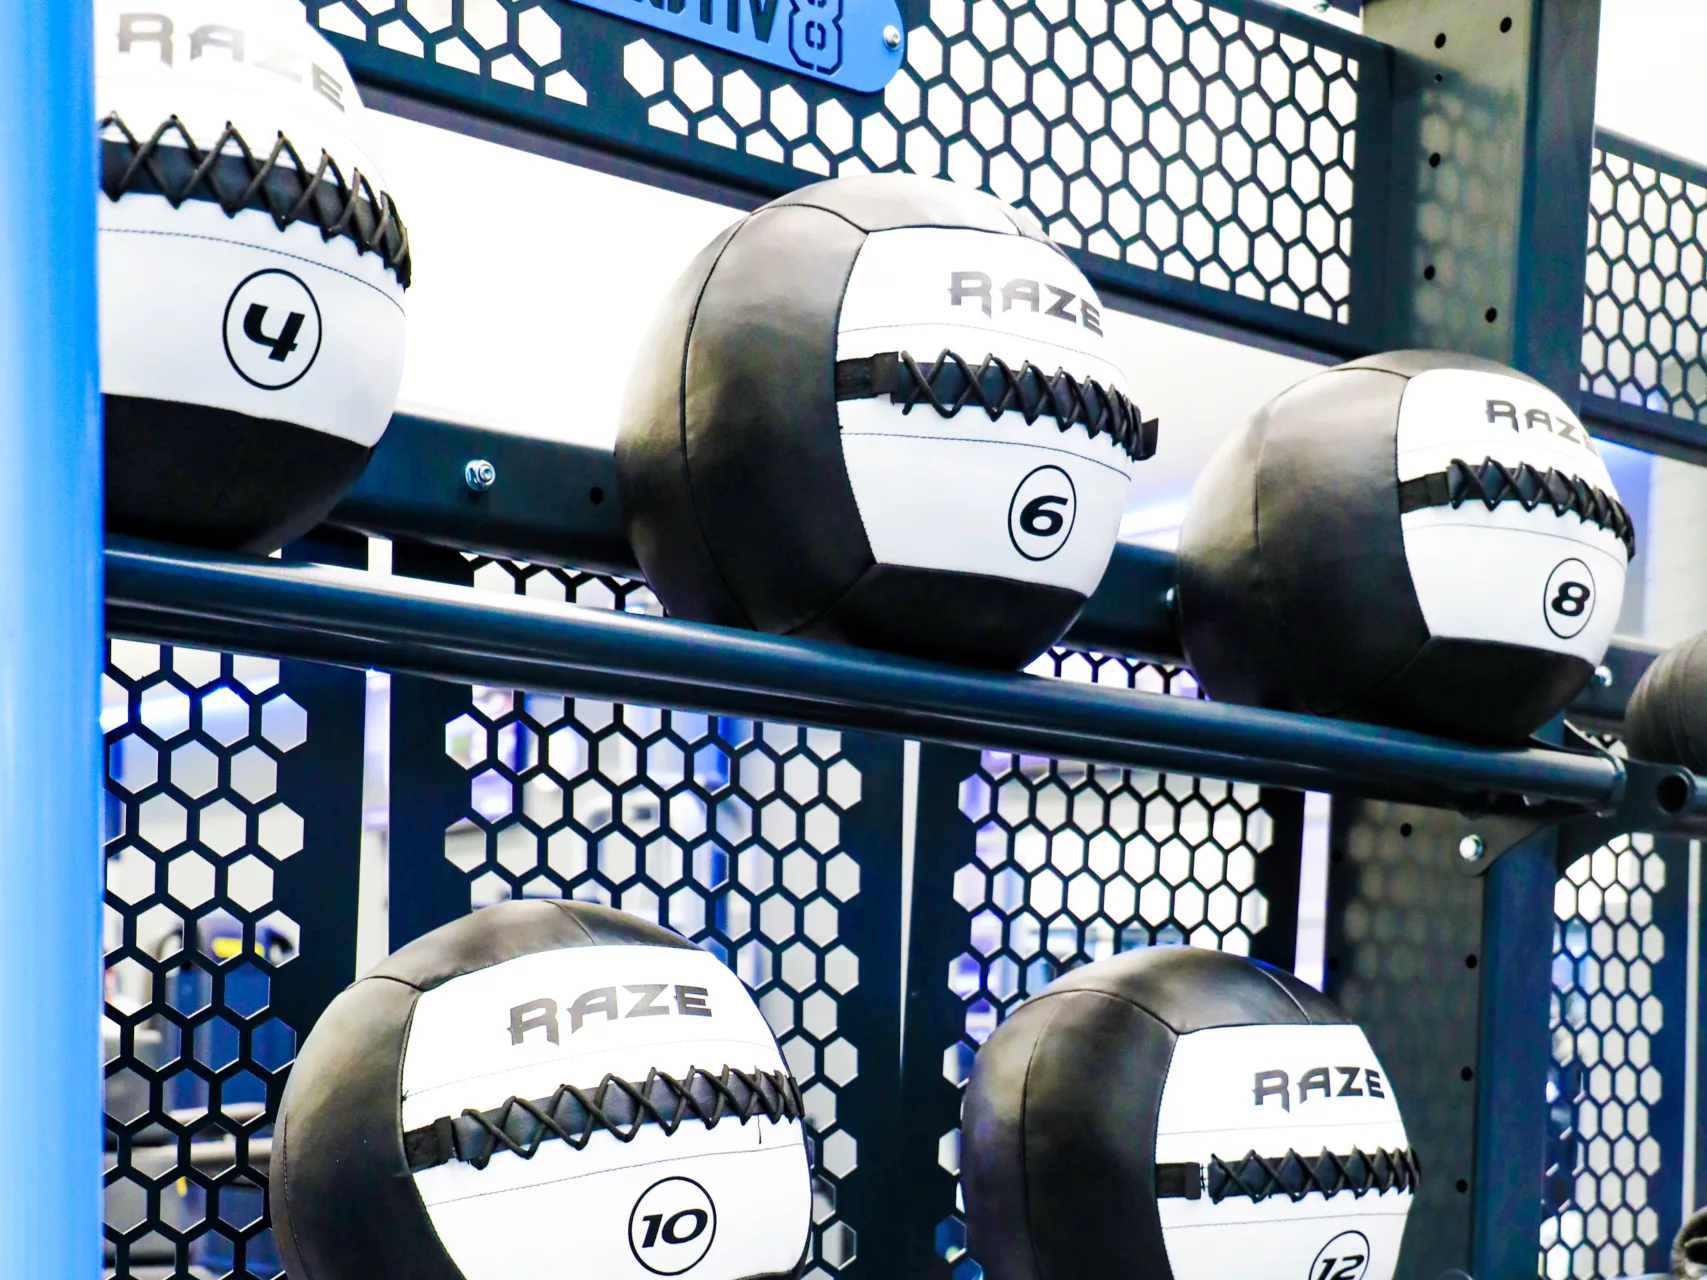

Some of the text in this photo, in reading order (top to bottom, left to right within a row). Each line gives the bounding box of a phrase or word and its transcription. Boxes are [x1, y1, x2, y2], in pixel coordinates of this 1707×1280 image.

[948, 270, 1104, 338] RAZE
[243, 302, 305, 362] 4
[1484, 399, 1597, 457] RAZ
[1019, 495, 1068, 537] 6
[1551, 581, 1590, 616] 8
[506, 983, 713, 1046] RAZE
[1251, 1066, 1385, 1113] RAZE
[641, 1208, 709, 1248] 10
